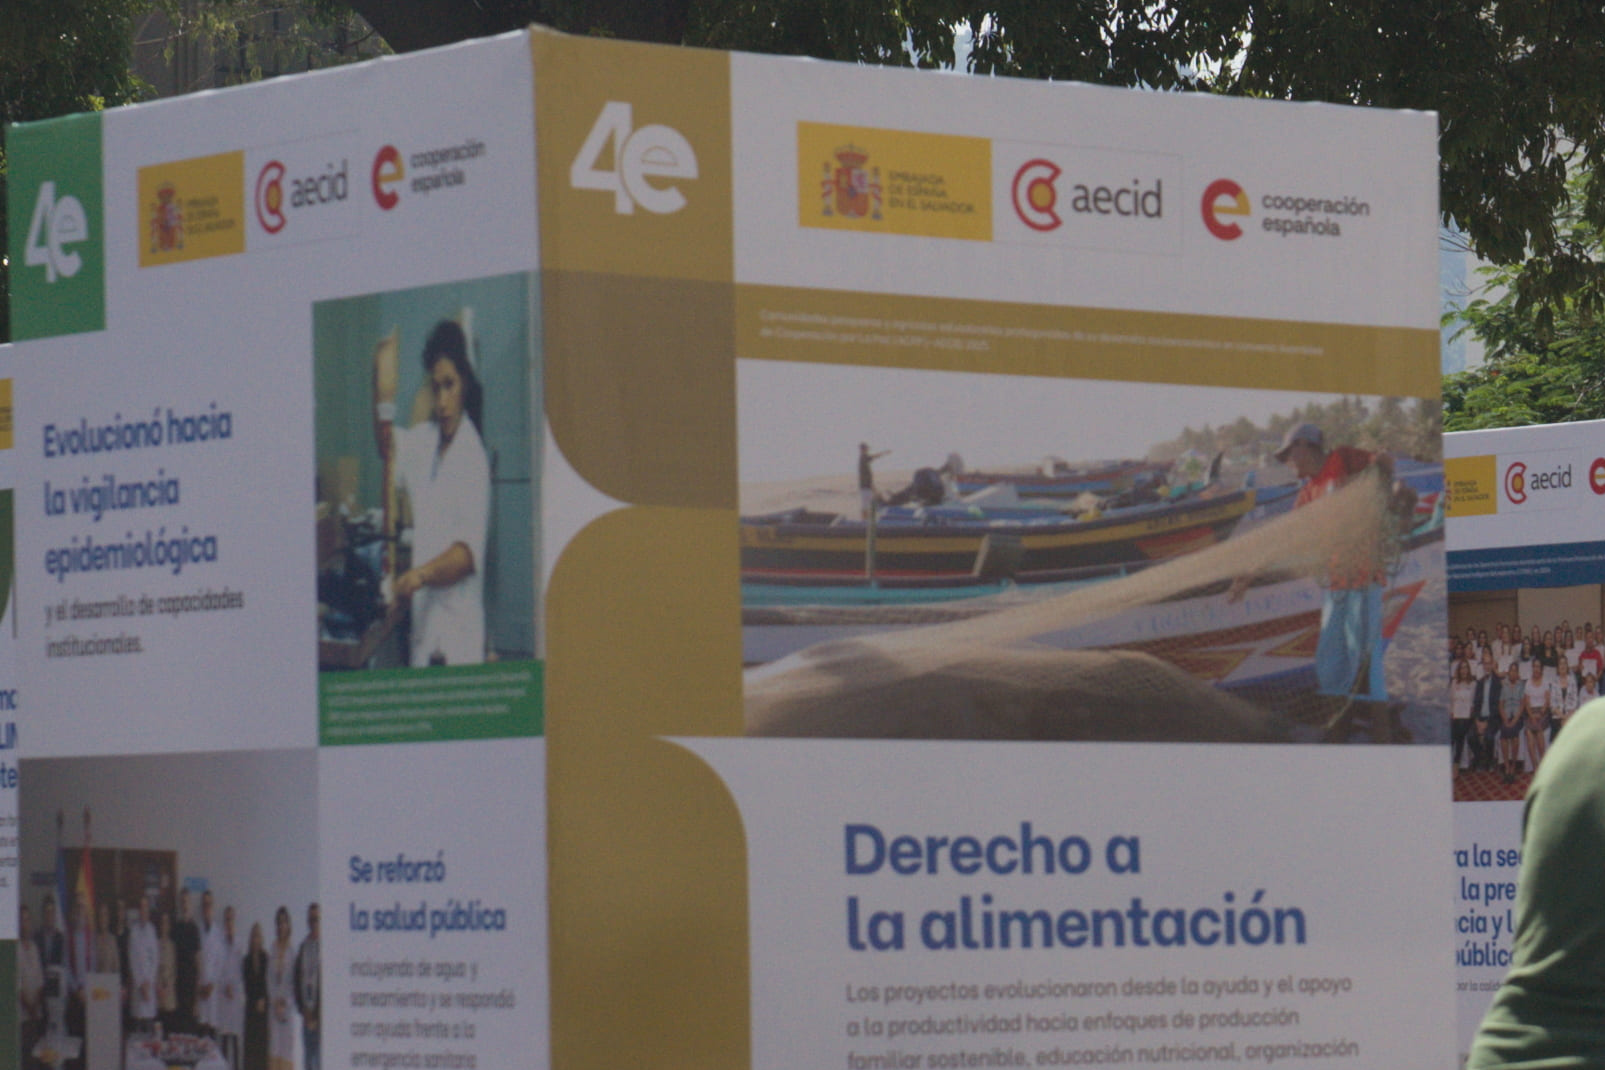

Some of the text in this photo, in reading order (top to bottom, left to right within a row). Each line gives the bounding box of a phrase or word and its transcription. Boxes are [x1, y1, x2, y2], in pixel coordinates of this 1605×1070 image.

[291, 159, 348, 208] aecid
[1072, 180, 1162, 218] aecid
[1262, 191, 1370, 217] cooperación
[1262, 215, 1341, 239] española
[43, 402, 232, 458] Evolucionó hacia
[1530, 464, 1572, 492] aecid
[44, 468, 180, 522] la vigilancia
[45, 525, 218, 583] epidemiológica
[843, 820, 1142, 876] Derecho a
[1473, 843, 1491, 867] la
[349, 850, 445, 883] Se reforzó
[1461, 876, 1516, 907] la pre
[349, 899, 507, 939] la salud pública
[846, 889, 1307, 951] la alimentación
[1455, 909, 1503, 940] cia y
[847, 975, 1352, 1005] Los proyectos evolucionaron desde la ayuda y el apoyo
[846, 1008, 1300, 1038] a la productividad hacia enfoques de producción
[848, 1039, 1359, 1070] familiar sostenible, educación nutricional, organización
